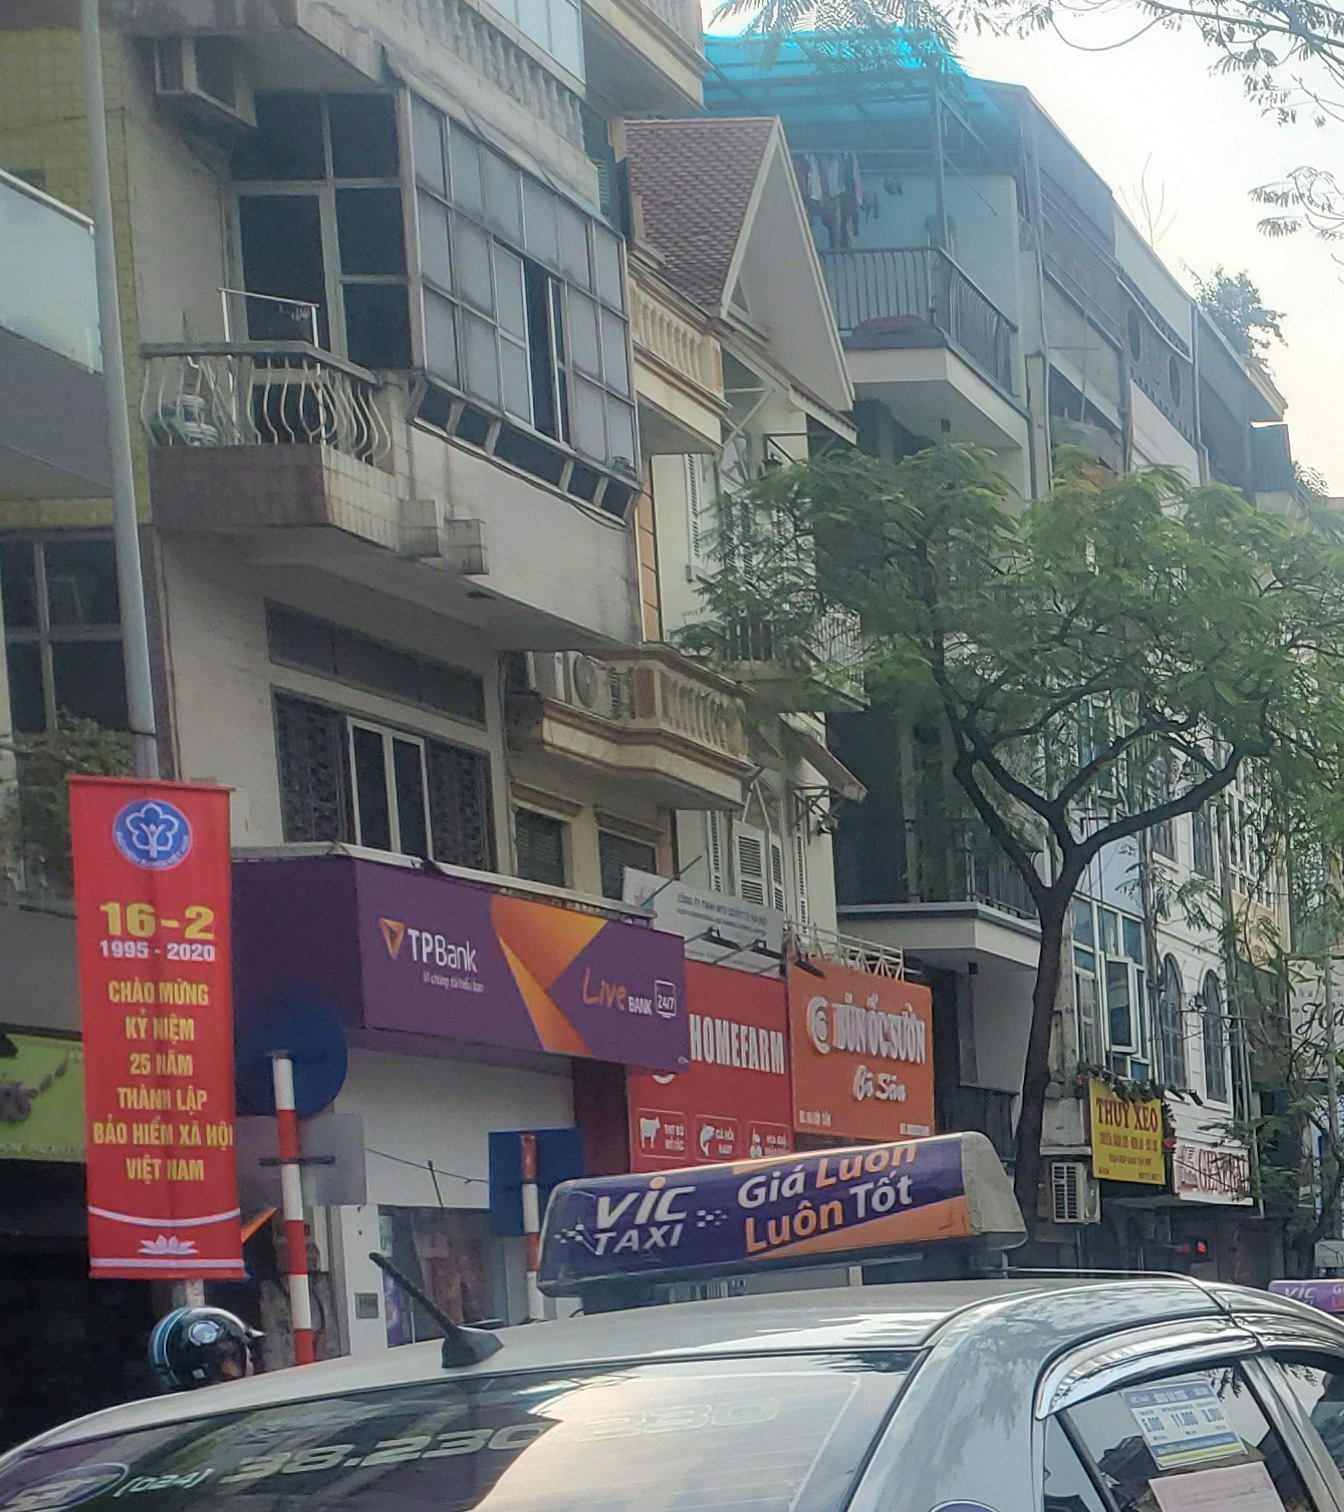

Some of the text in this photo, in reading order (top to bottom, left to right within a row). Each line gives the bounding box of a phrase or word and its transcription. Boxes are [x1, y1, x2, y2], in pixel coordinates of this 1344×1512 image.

[100, 939, 216, 962] 1995 2020
[407, 928, 478, 973] TPBank
[108, 976, 209, 1005] CHÀO MỪNG
[582, 967, 627, 1010] Live
[628, 996, 652, 1016] BANK
[125, 1008, 195, 1045] KỶ NIỆM
[689, 1014, 785, 1075] HOMEFARM
[129, 1050, 193, 1076] 25 NĂM
[117, 1083, 208, 1115] THÀNH LẬP
[93, 1113, 233, 1151] BẢO HIỂM XÃ HỘI
[125, 1154, 204, 1184] VIỆT NAM
[737, 1162, 805, 1209] Giá
[745, 1174, 914, 1254] Luôn Tốt
[594, 1222, 683, 1256] TAXI
